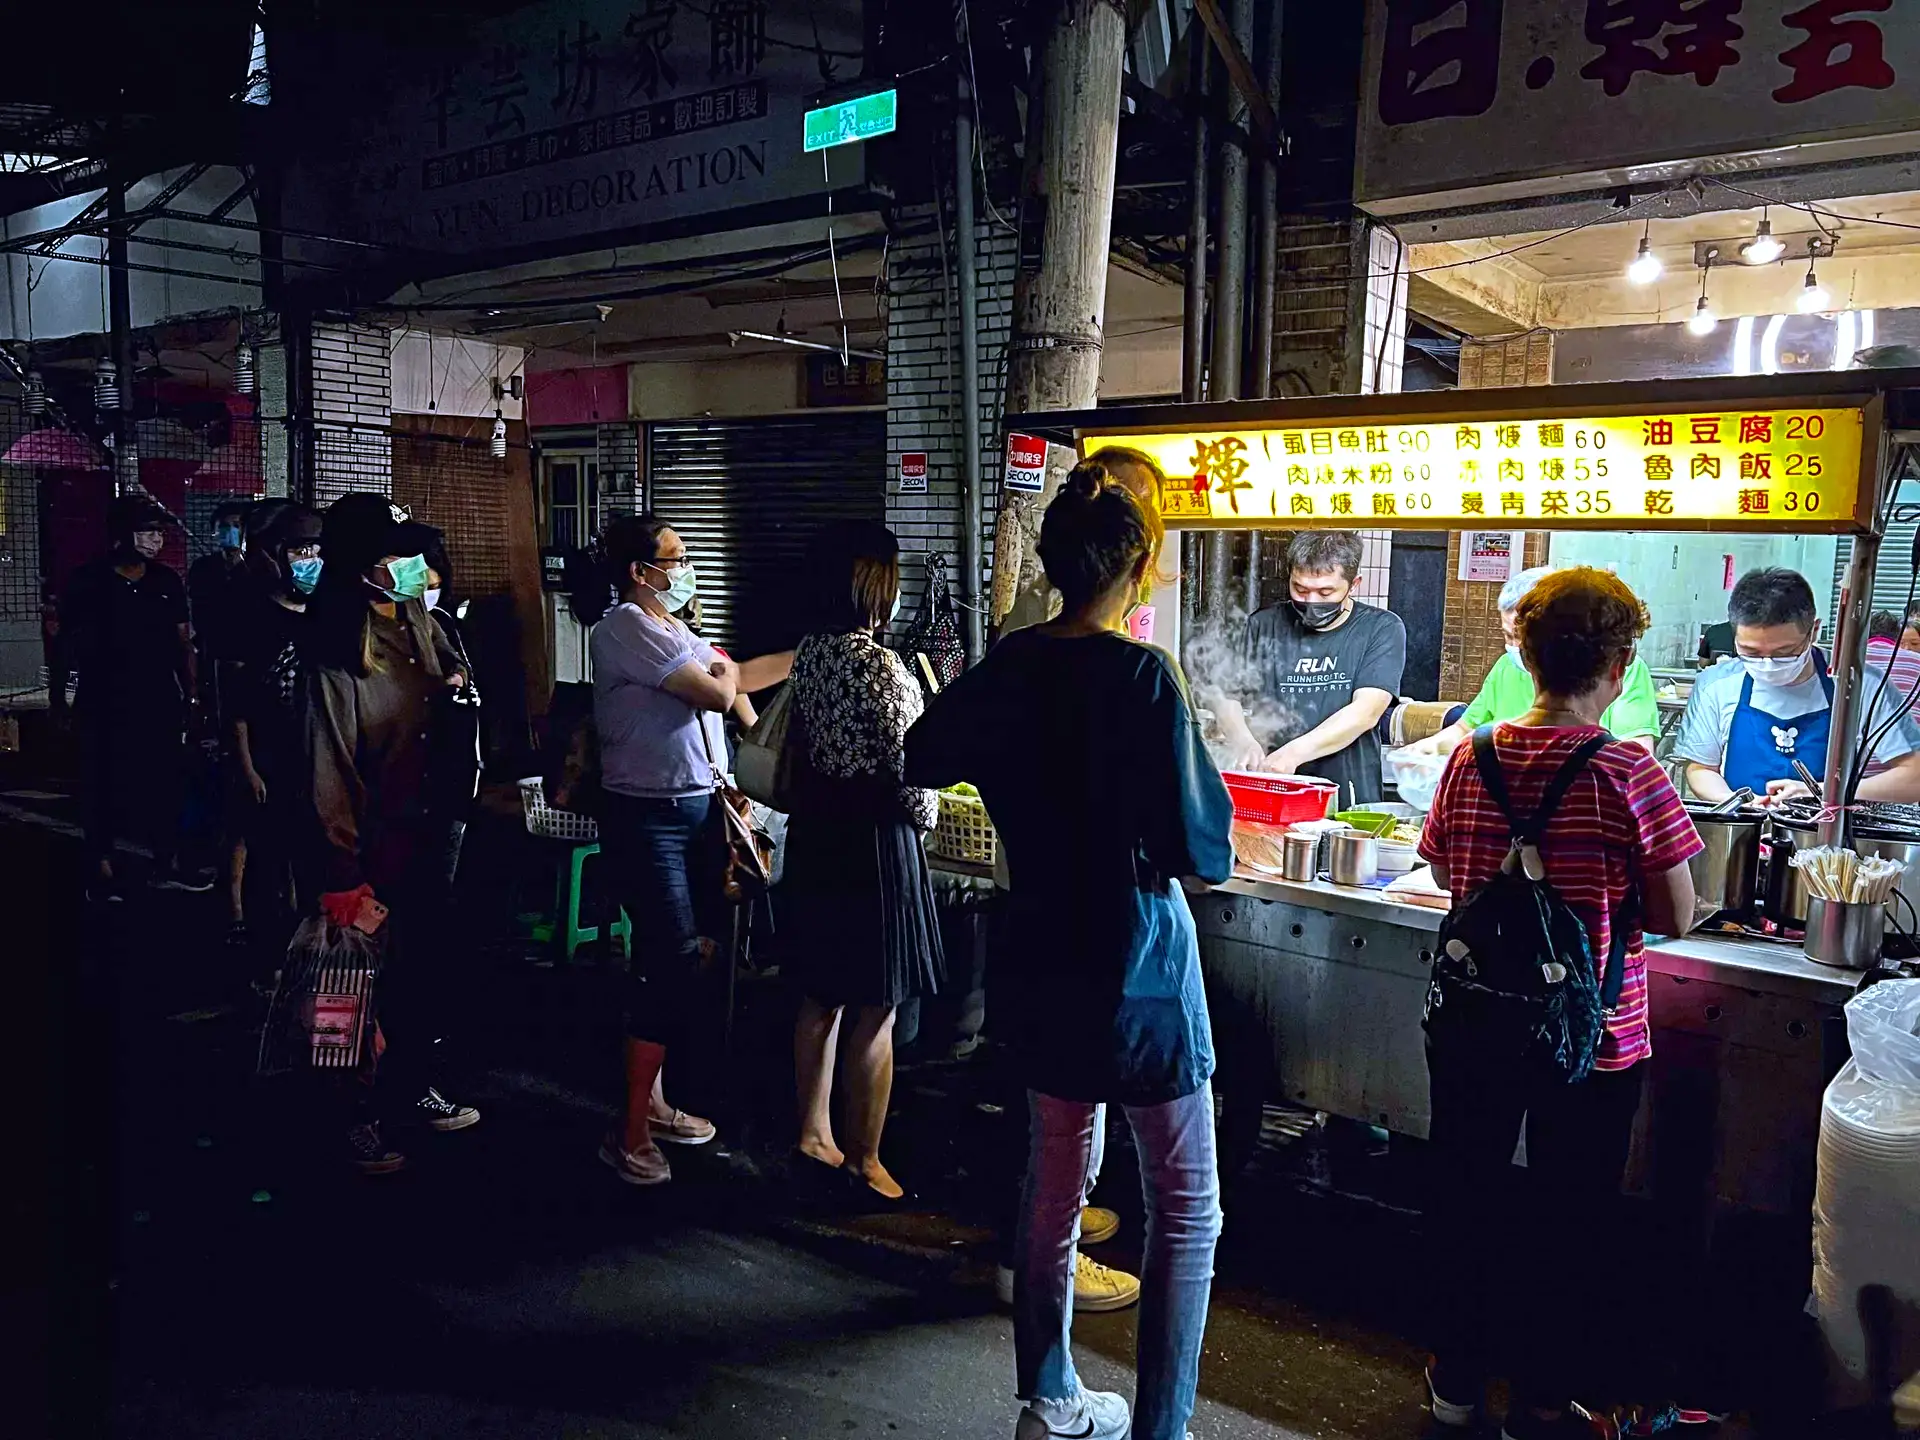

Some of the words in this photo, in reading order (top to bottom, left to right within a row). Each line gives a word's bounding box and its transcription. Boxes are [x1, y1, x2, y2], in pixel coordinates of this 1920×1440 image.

[807, 130, 836, 145] EXIT
[520, 140, 769, 222] DECORATION
[1576, 430, 1606, 449] 60
[1643, 415, 1773, 446] 油豆腐
[1786, 415, 1824, 440] 20
[1283, 429, 1389, 455] 虱目魚肚
[1399, 431, 1430, 453] 90
[1404, 463, 1430, 482] 60
[1575, 458, 1608, 481] 55
[1643, 452, 1773, 481] 魯肉飯
[1785, 453, 1822, 477] 25
[902, 478, 925, 486] SECOM
[1007, 470, 1040, 483] SECOM
[1405, 493, 1432, 509] 60
[1575, 490, 1611, 514] 35
[1783, 491, 1820, 513] 30
[1139, 612, 1152, 626] 6
[1295, 656, 1338, 673] RUN
